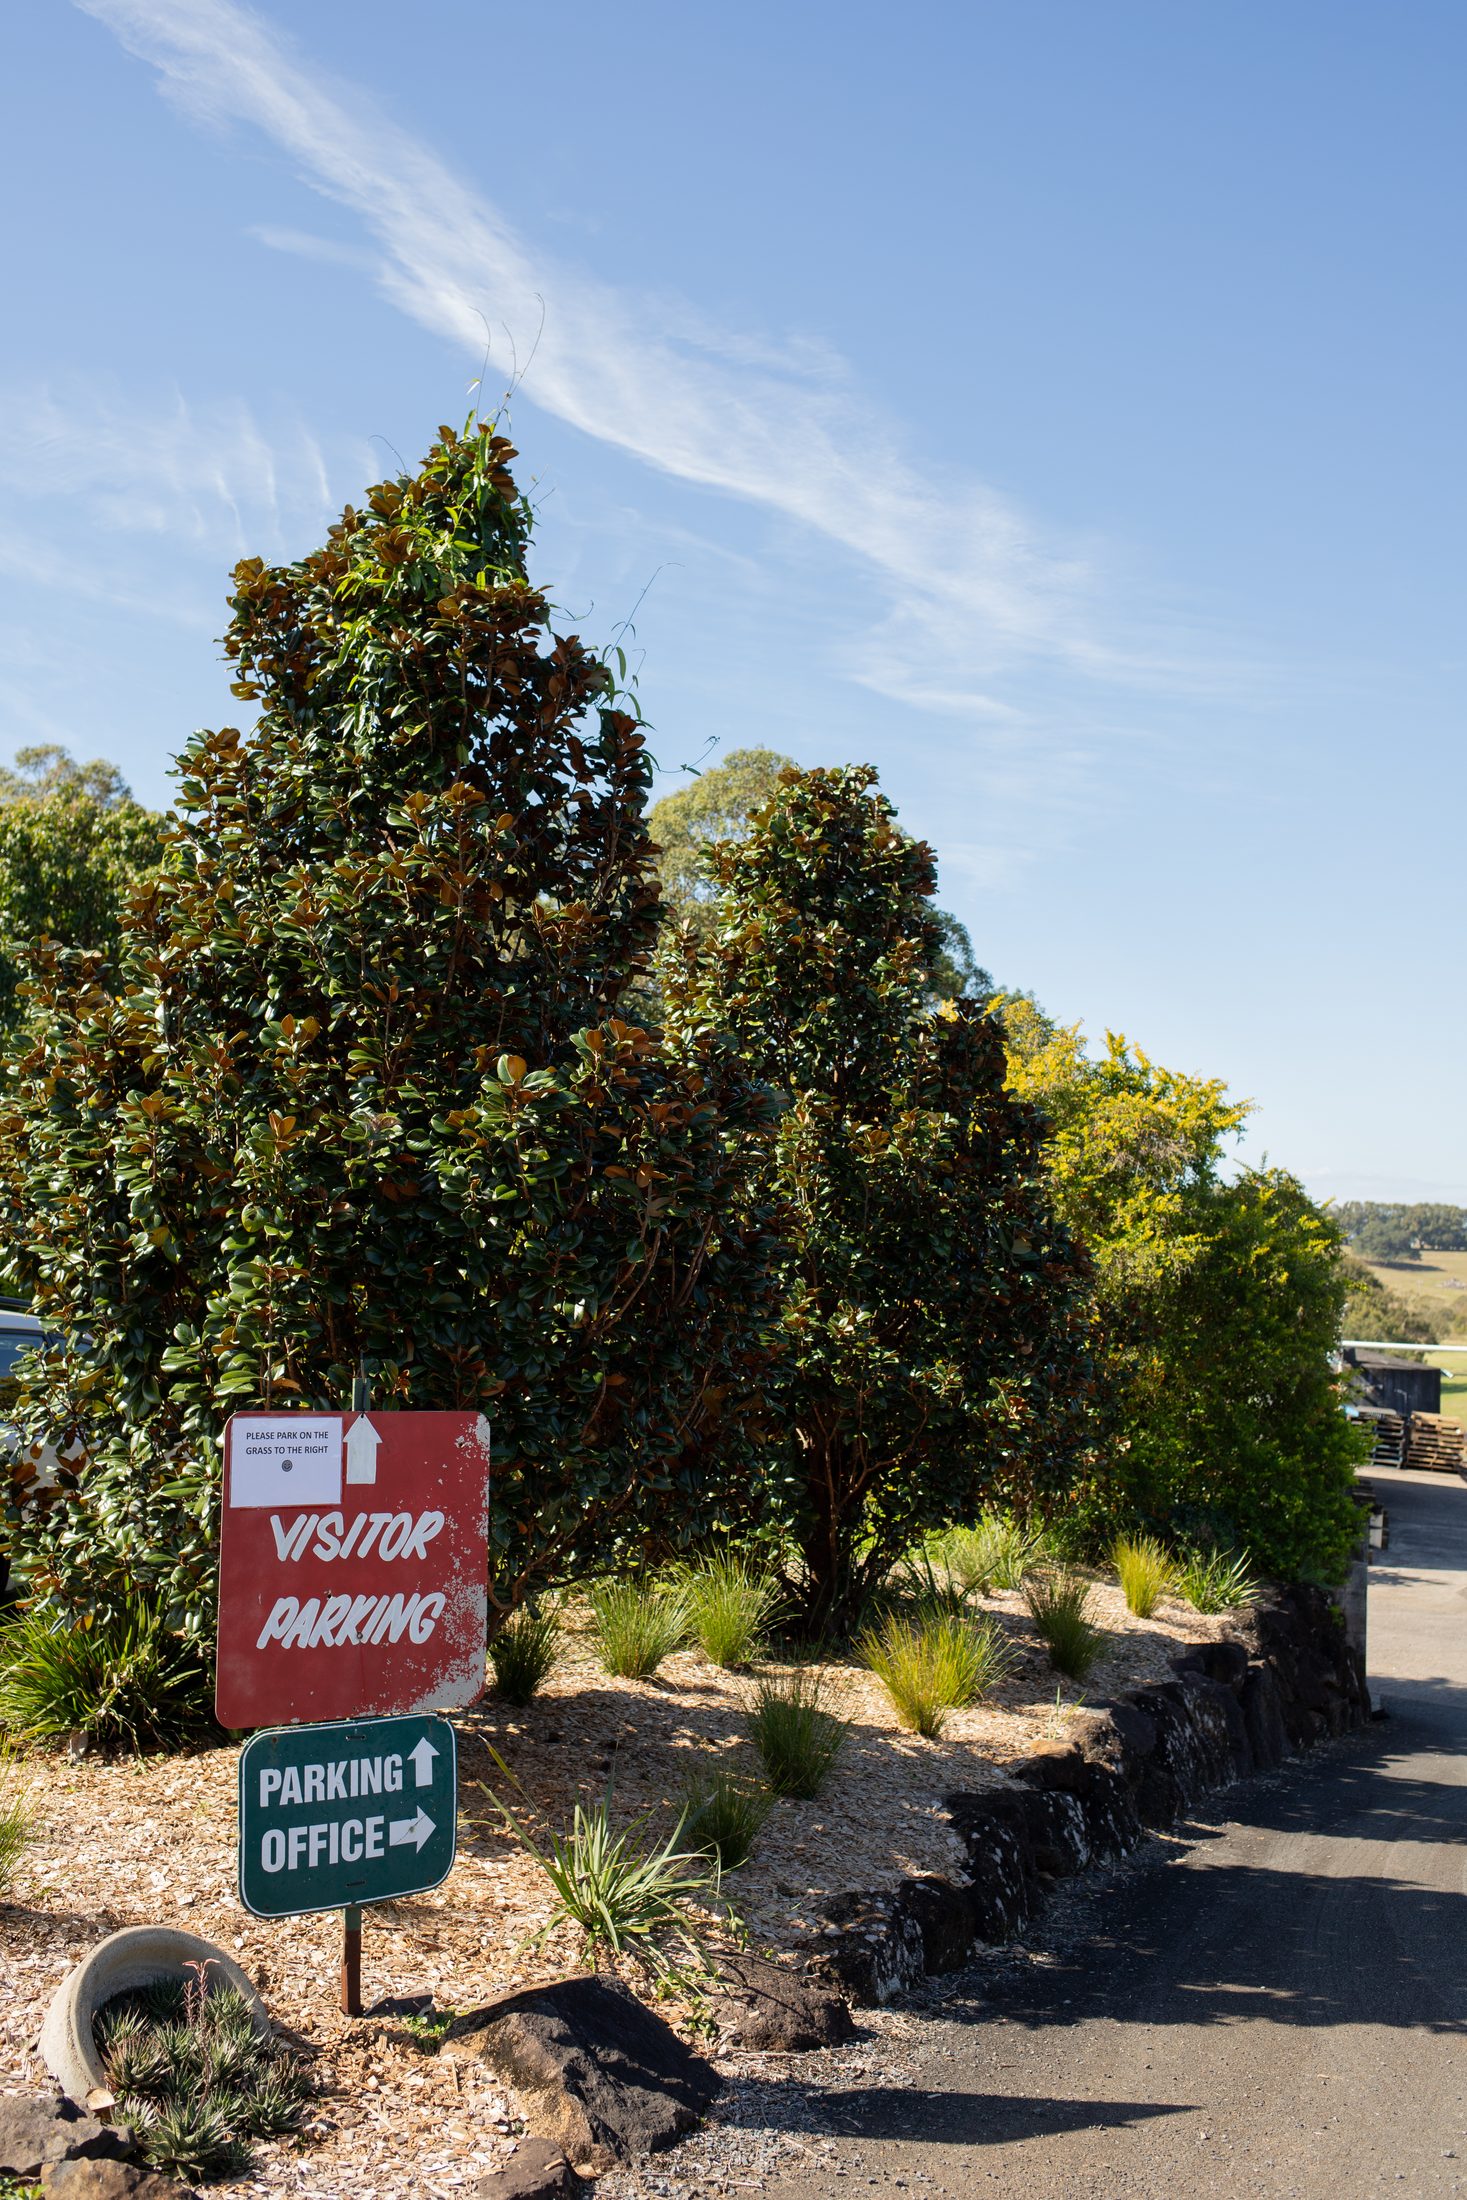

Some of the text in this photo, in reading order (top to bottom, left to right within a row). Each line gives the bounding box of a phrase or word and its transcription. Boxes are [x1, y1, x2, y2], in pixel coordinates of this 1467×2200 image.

[246, 1432, 274, 1440] PLEASE
[277, 1432, 298, 1440] PARK
[314, 1431, 329, 1439] THE
[246, 1447, 272, 1455] GRASS
[287, 1446, 302, 1454] THE
[304, 1446, 329, 1454] RIGHT
[269, 1510, 445, 1562] VISITOR
[255, 1591, 446, 1650] PARKING
[259, 1753, 403, 1808] PARKING
[261, 1815, 385, 1873] OFFICE
